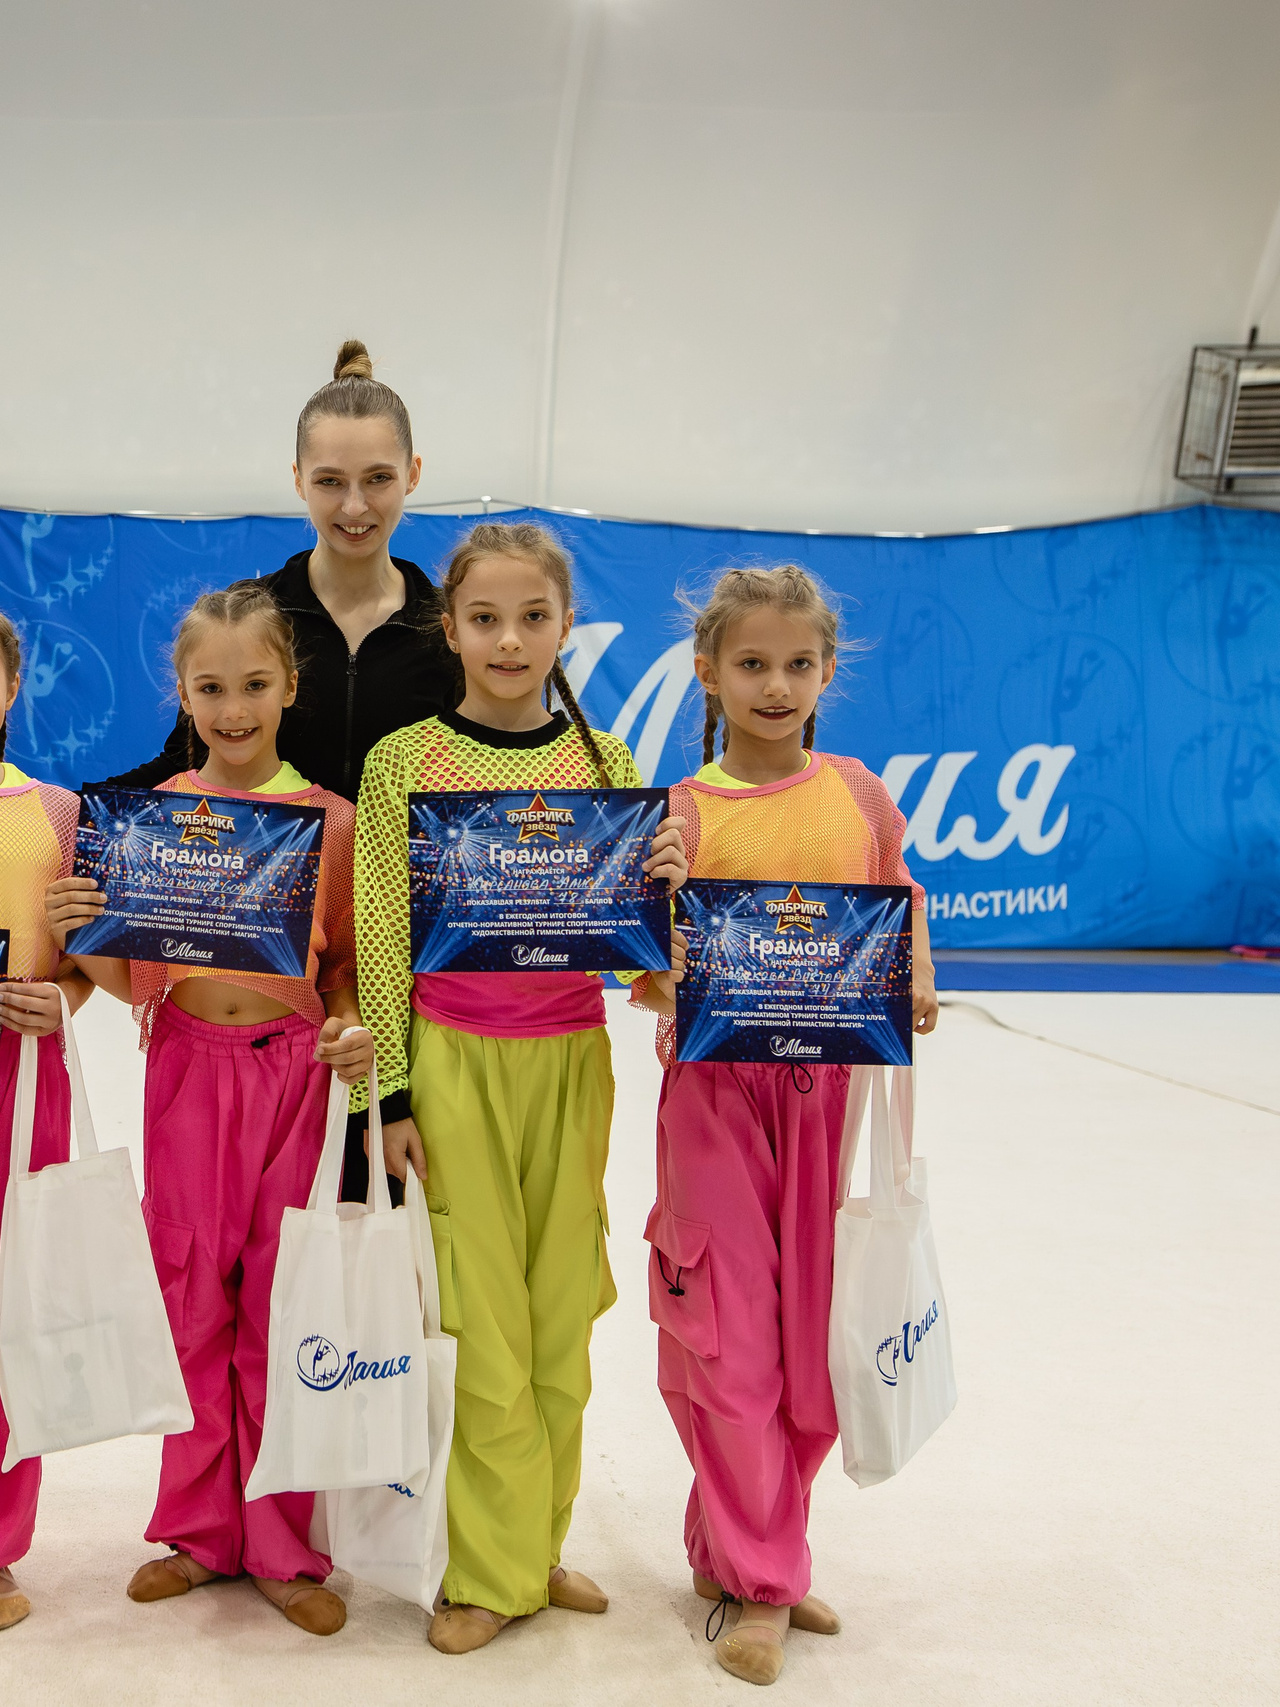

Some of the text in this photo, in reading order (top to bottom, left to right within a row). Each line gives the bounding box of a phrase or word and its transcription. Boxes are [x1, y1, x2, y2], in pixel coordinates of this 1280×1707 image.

[170, 811, 237, 832] ФАБРИКА
[506, 809, 575, 825] ФАБРИКА
[150, 841, 246, 875] Грамота
[489, 842, 589, 870] Грамота
[171, 867, 220, 878] НАГРАЖДАЕТСЯ
[124, 890, 169, 901] ПОКАЗАВШАЯ
[169, 895, 203, 904] РЕЗУЛЬТАТ
[234, 902, 261, 911] БАЛЛОВ
[159, 908, 199, 918] ЕЖЕГОДНОМ
[200, 912, 236, 921] ИТОГОВОМ
[765, 900, 828, 918] ФАБРИКА
[103, 909, 284, 934] ОТЧЕТНО-НОРМАТИВНОМ ТУРНИРЕ СПОРТИВНОГО КЛУБА
[125, 918, 260, 939] ХУДОЖЕСТВЕННОЙ ГИМНАСТИКИ «МАГИЯ»
[471, 928, 535, 936] ХУДОЖЕСТВЕННОЙ
[174, 941, 215, 959] Магия
[527, 946, 569, 962] Магия
[749, 933, 840, 962] Грамота
[771, 959, 818, 967] НАГРАЖДАЕТСЯ
[710, 1010, 789, 1018] ОТЧЕТНО-НОРМАТИВНОМ
[764, 1003, 802, 1011] ЕЖЕГОДНОМ
[732, 1018, 791, 1027] ХУДОЖЕСТВЕННОЙ
[784, 1038, 822, 1054] Магия
